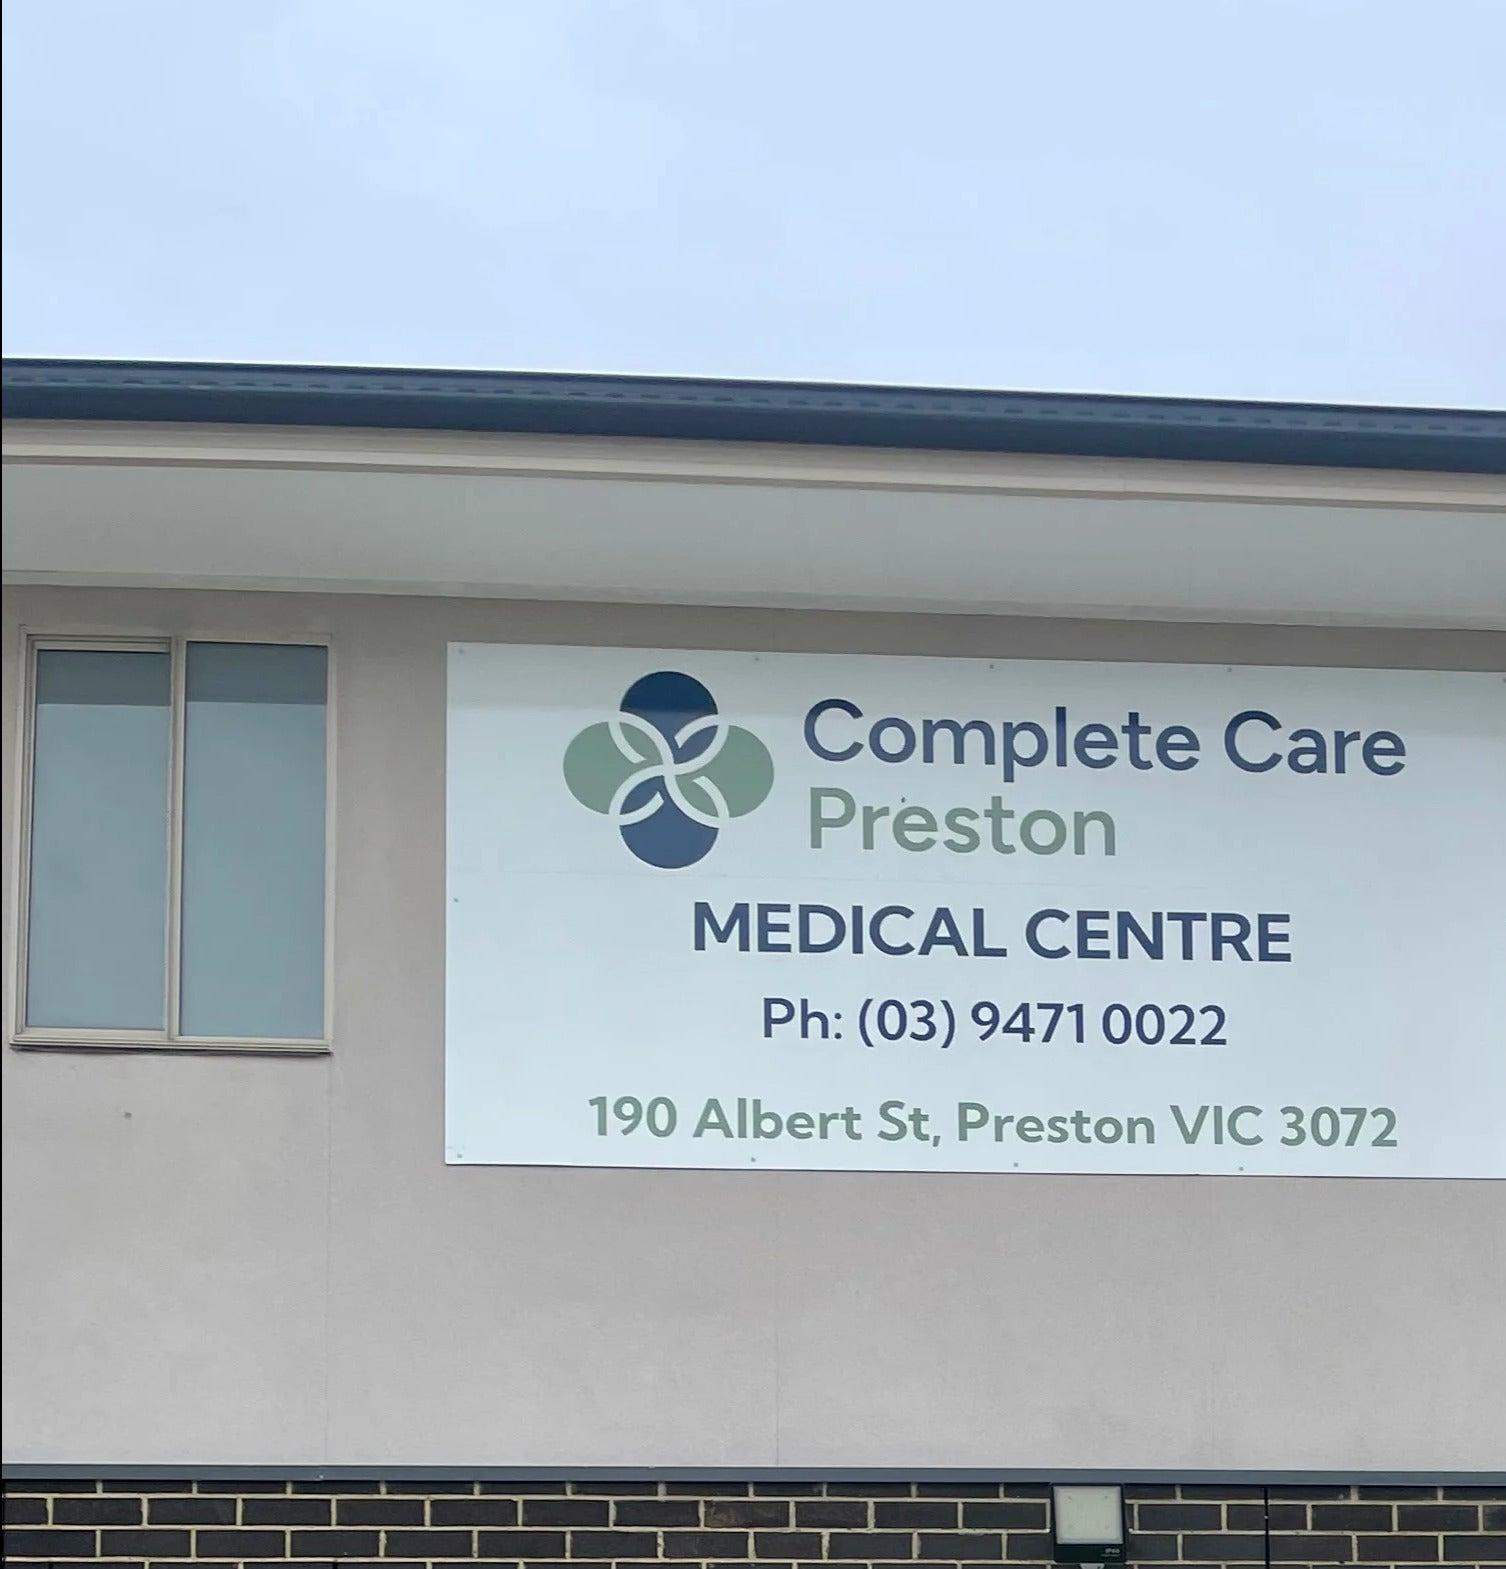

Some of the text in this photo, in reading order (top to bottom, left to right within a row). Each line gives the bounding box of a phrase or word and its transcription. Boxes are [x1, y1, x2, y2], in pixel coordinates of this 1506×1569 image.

[803, 698, 1406, 784] Complete Care
[809, 785, 1116, 858] Preston
[693, 901, 1292, 963] MEDICAL CENTRE
[763, 997, 1227, 1049] Ph: (03) 9471 0022
[588, 1095, 1398, 1148] 190 Albert St, Preston VIC 3072
